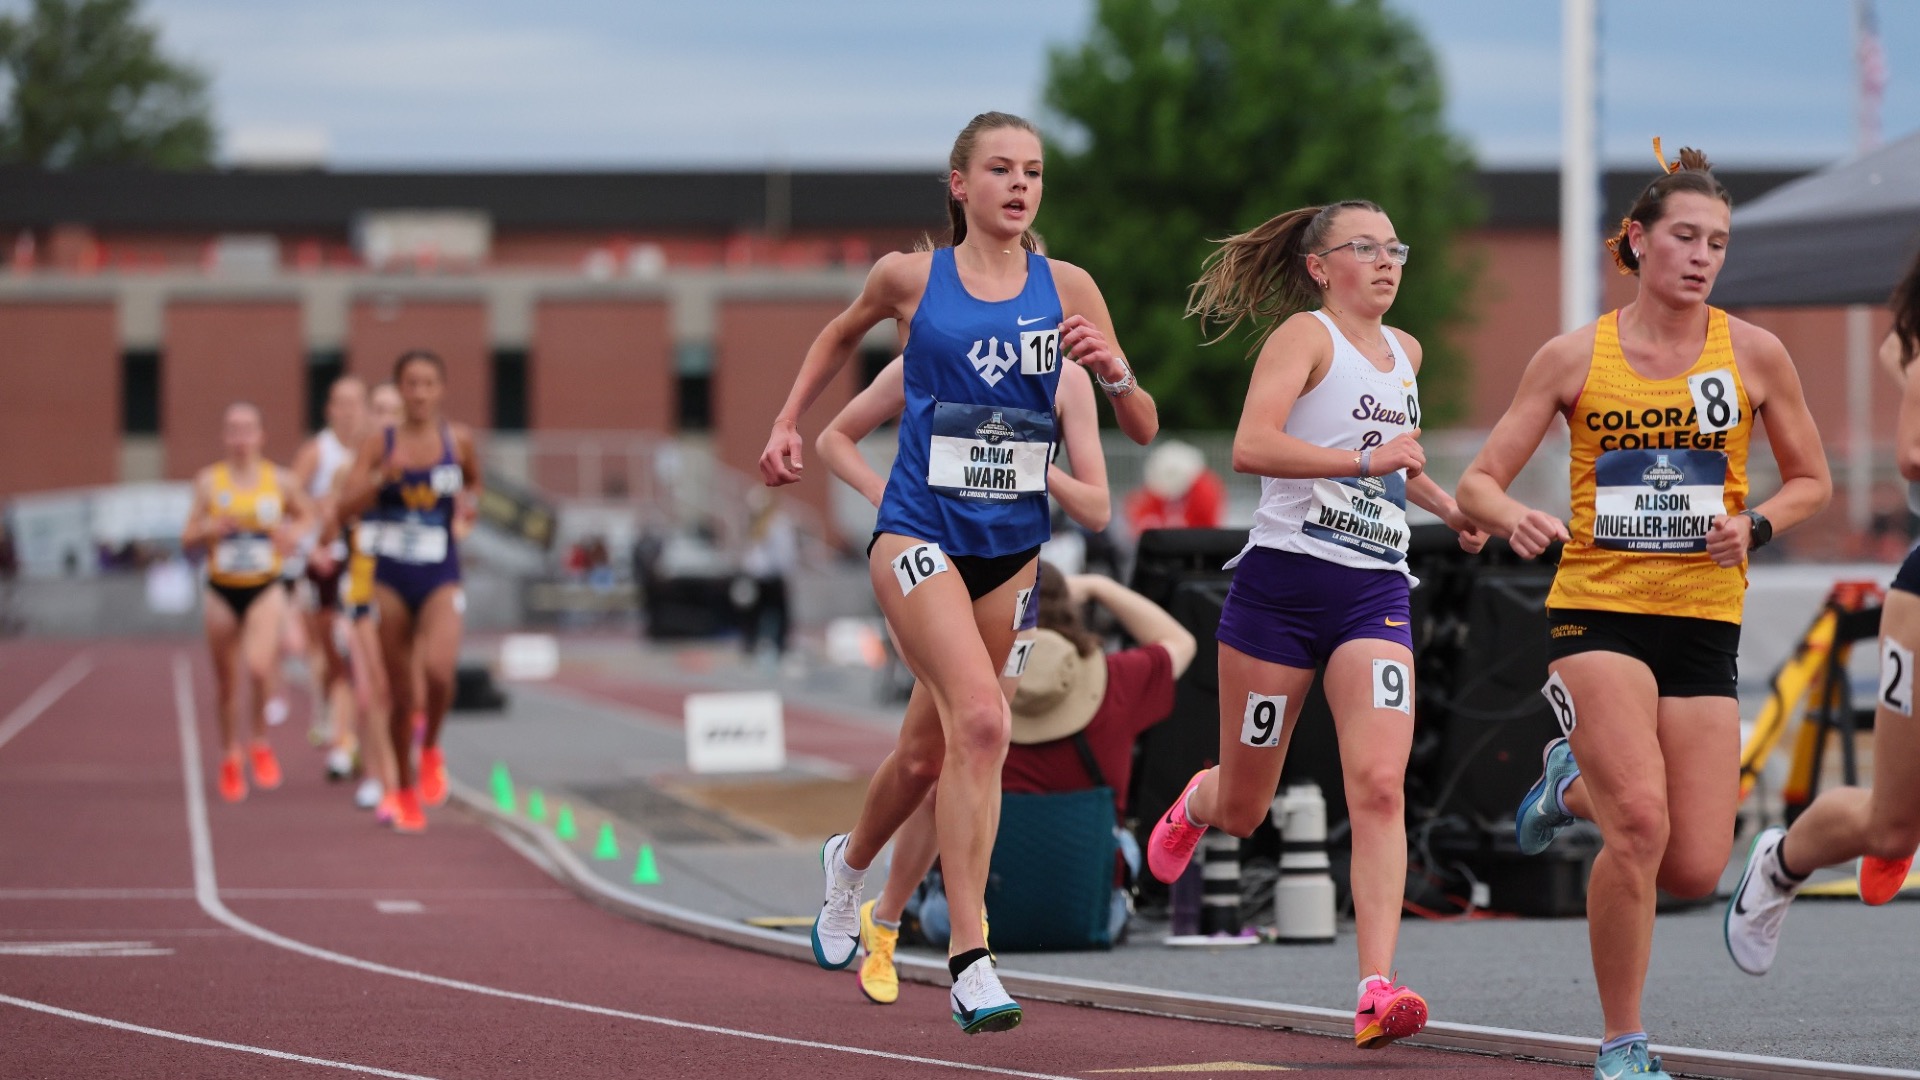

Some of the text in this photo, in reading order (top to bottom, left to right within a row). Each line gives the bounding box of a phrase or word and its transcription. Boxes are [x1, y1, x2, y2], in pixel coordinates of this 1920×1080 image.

[1030, 334, 1054, 372] 16
[1407, 394, 1417, 430] 9
[1586, 407, 1741, 432] COLORA
[1701, 377, 1731, 428] 8
[970, 446, 1014, 464] OLIVIA
[1354, 430, 1384, 451] P
[1600, 430, 1728, 450] COLLEGE
[964, 466, 1017, 489] WARR
[1351, 495, 1382, 520] FAITH
[1635, 494, 1690, 511] ALISON
[1319, 505, 1402, 548] WEHRMAN
[1628, 541, 1694, 549] LA CROSSE, WISCONSIN
[900, 546, 935, 586] 16
[1382, 664, 1404, 707] 9
[1885, 651, 1902, 708] 2
[1250, 701, 1276, 745] 9
[1550, 684, 1572, 732] 8
